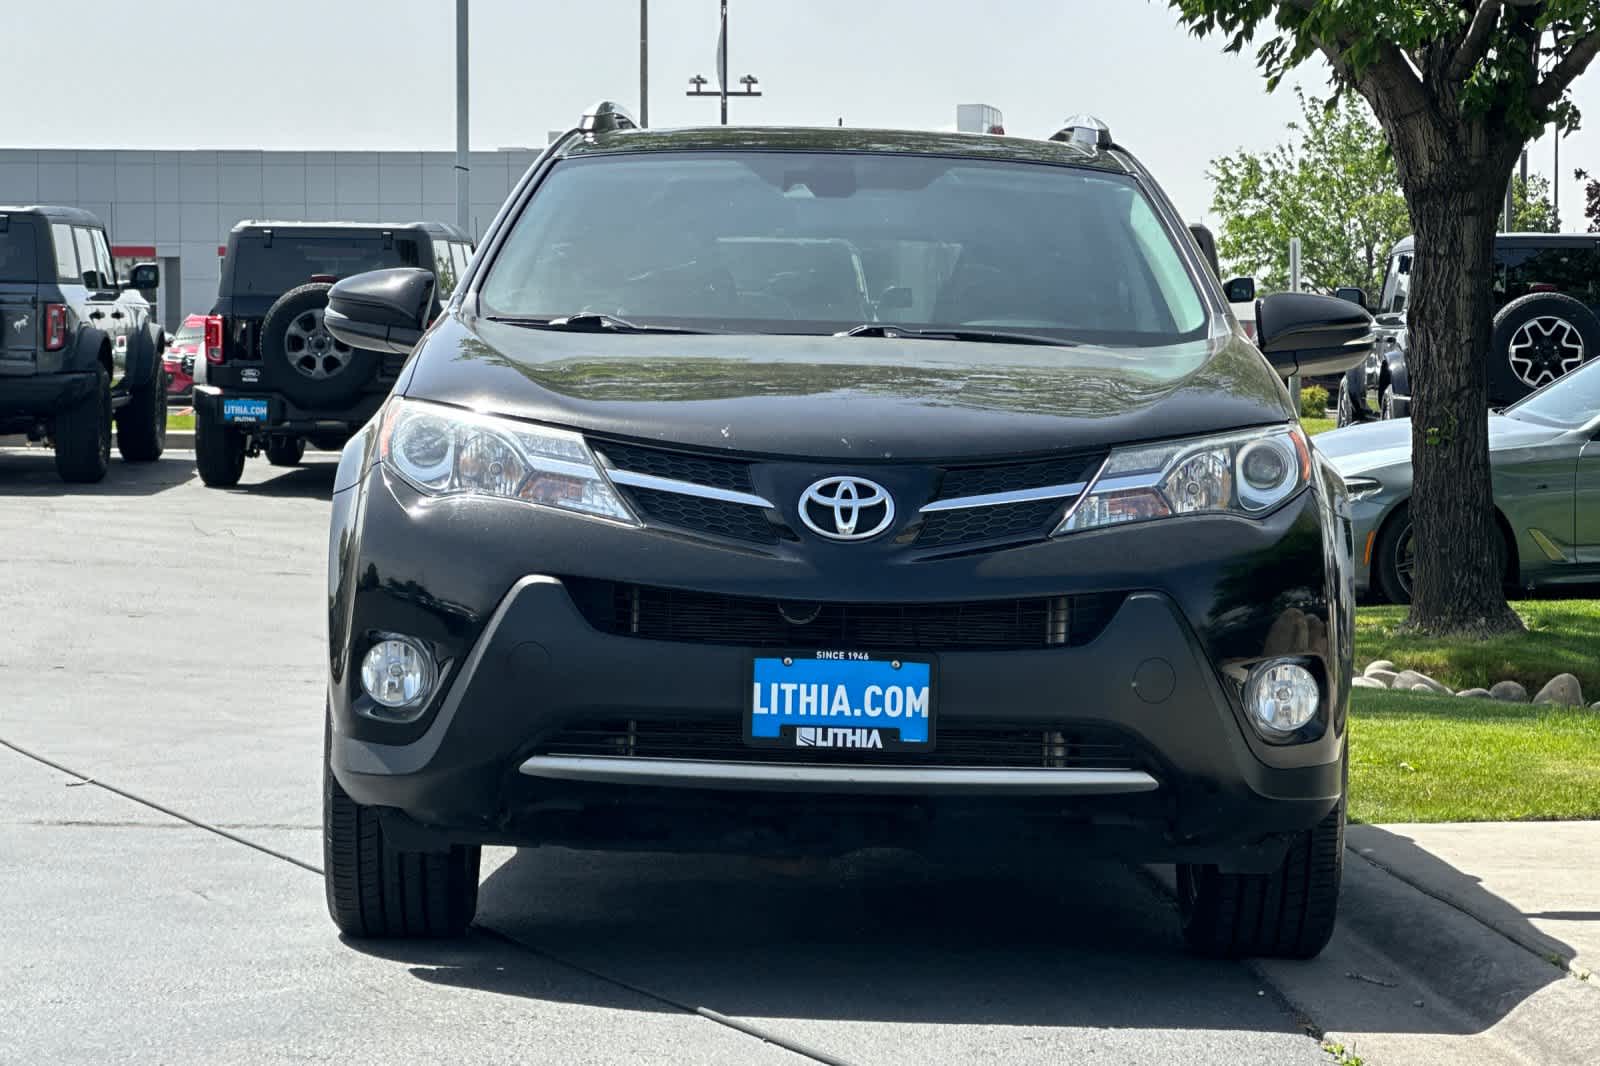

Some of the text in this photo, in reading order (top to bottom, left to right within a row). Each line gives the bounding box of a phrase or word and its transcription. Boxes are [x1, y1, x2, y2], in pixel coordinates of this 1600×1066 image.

[224, 405, 267, 416] LITHIA.COM
[816, 651, 869, 660] SINCE 1946
[753, 682, 929, 717] LITHIA.COM
[816, 727, 883, 748] LITHIA
